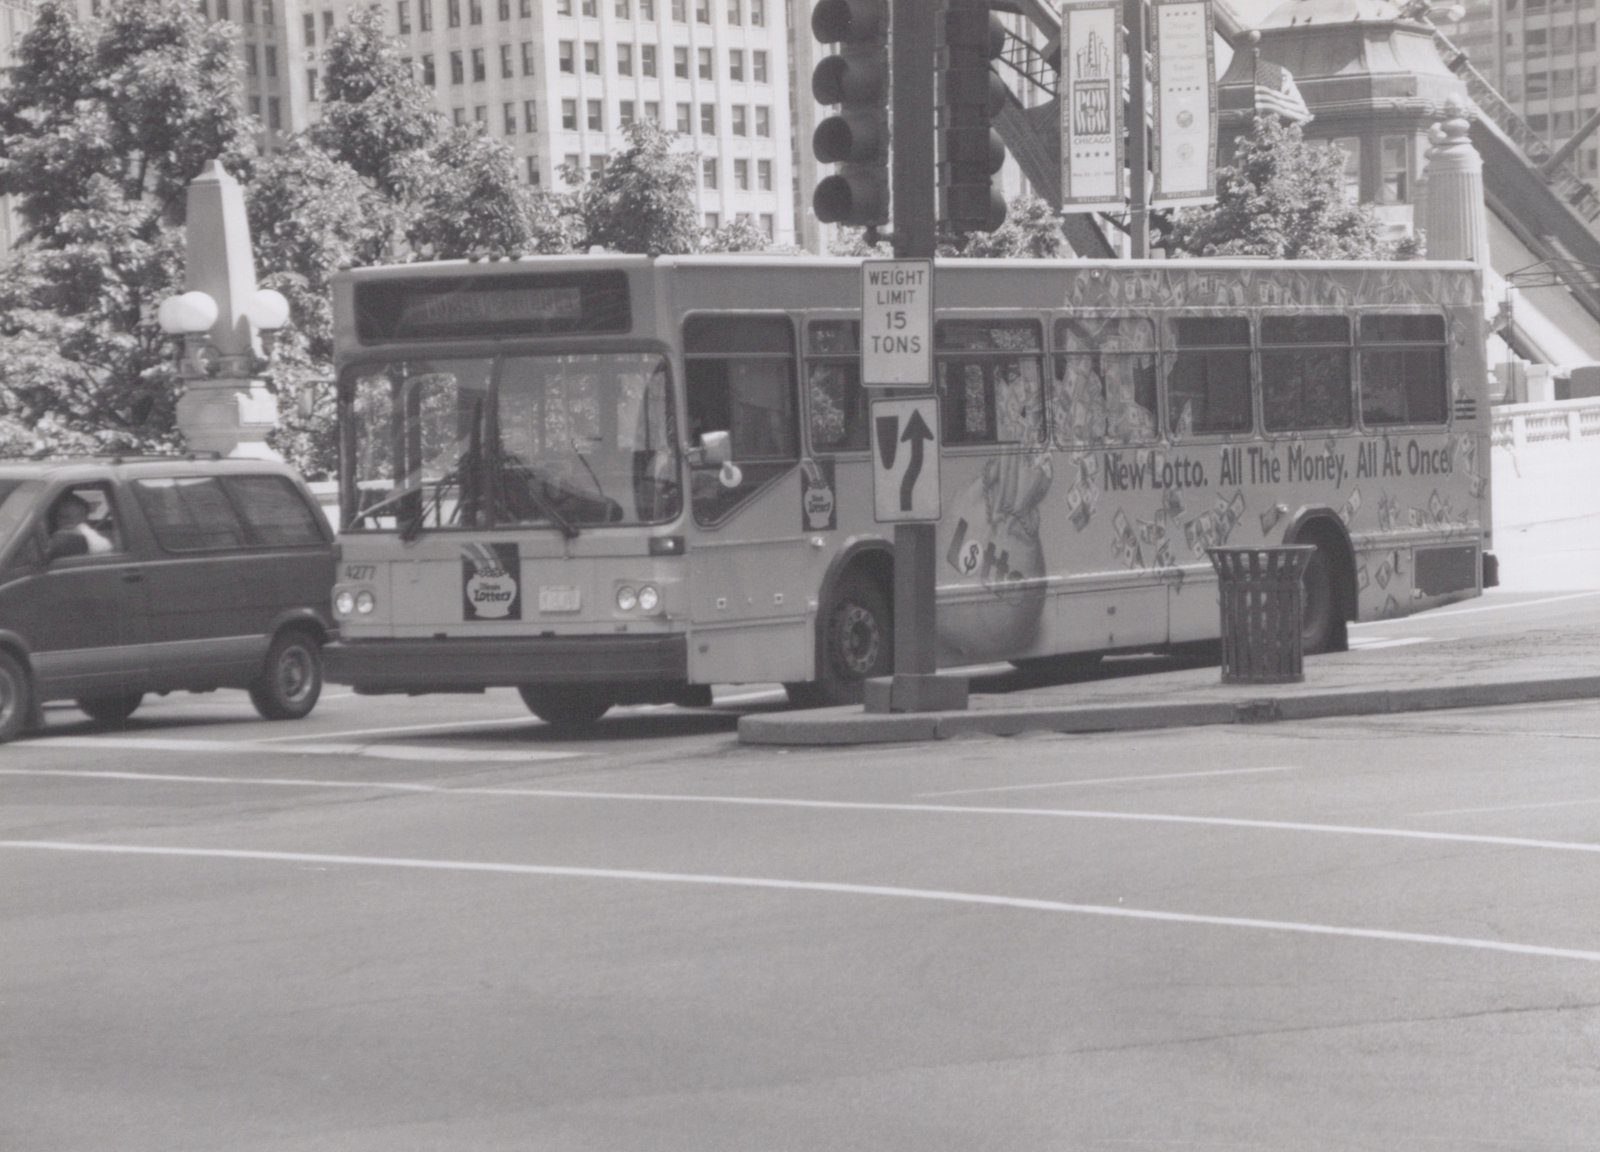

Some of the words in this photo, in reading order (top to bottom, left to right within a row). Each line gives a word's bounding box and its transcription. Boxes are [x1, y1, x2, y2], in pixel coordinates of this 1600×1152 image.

[1075, 90, 1108, 111] POW
[1075, 111, 1109, 133] WOW
[1073, 136, 1112, 145] CHICAGO
[868, 270, 924, 286] WEIGHT
[877, 290, 916, 305] LIMIT
[885, 311, 907, 330] 15
[871, 335, 922, 354] TONS
[1104, 452, 1146, 491] New
[1151, 451, 1209, 489] Lotto.
[1220, 447, 1242, 485] All
[1249, 447, 1281, 484] The
[1288, 445, 1348, 488] Money.
[1356, 441, 1377, 478] All
[1382, 441, 1402, 476] At
[344, 565, 377, 580] 4277
[474, 590, 512, 602] Lottery
